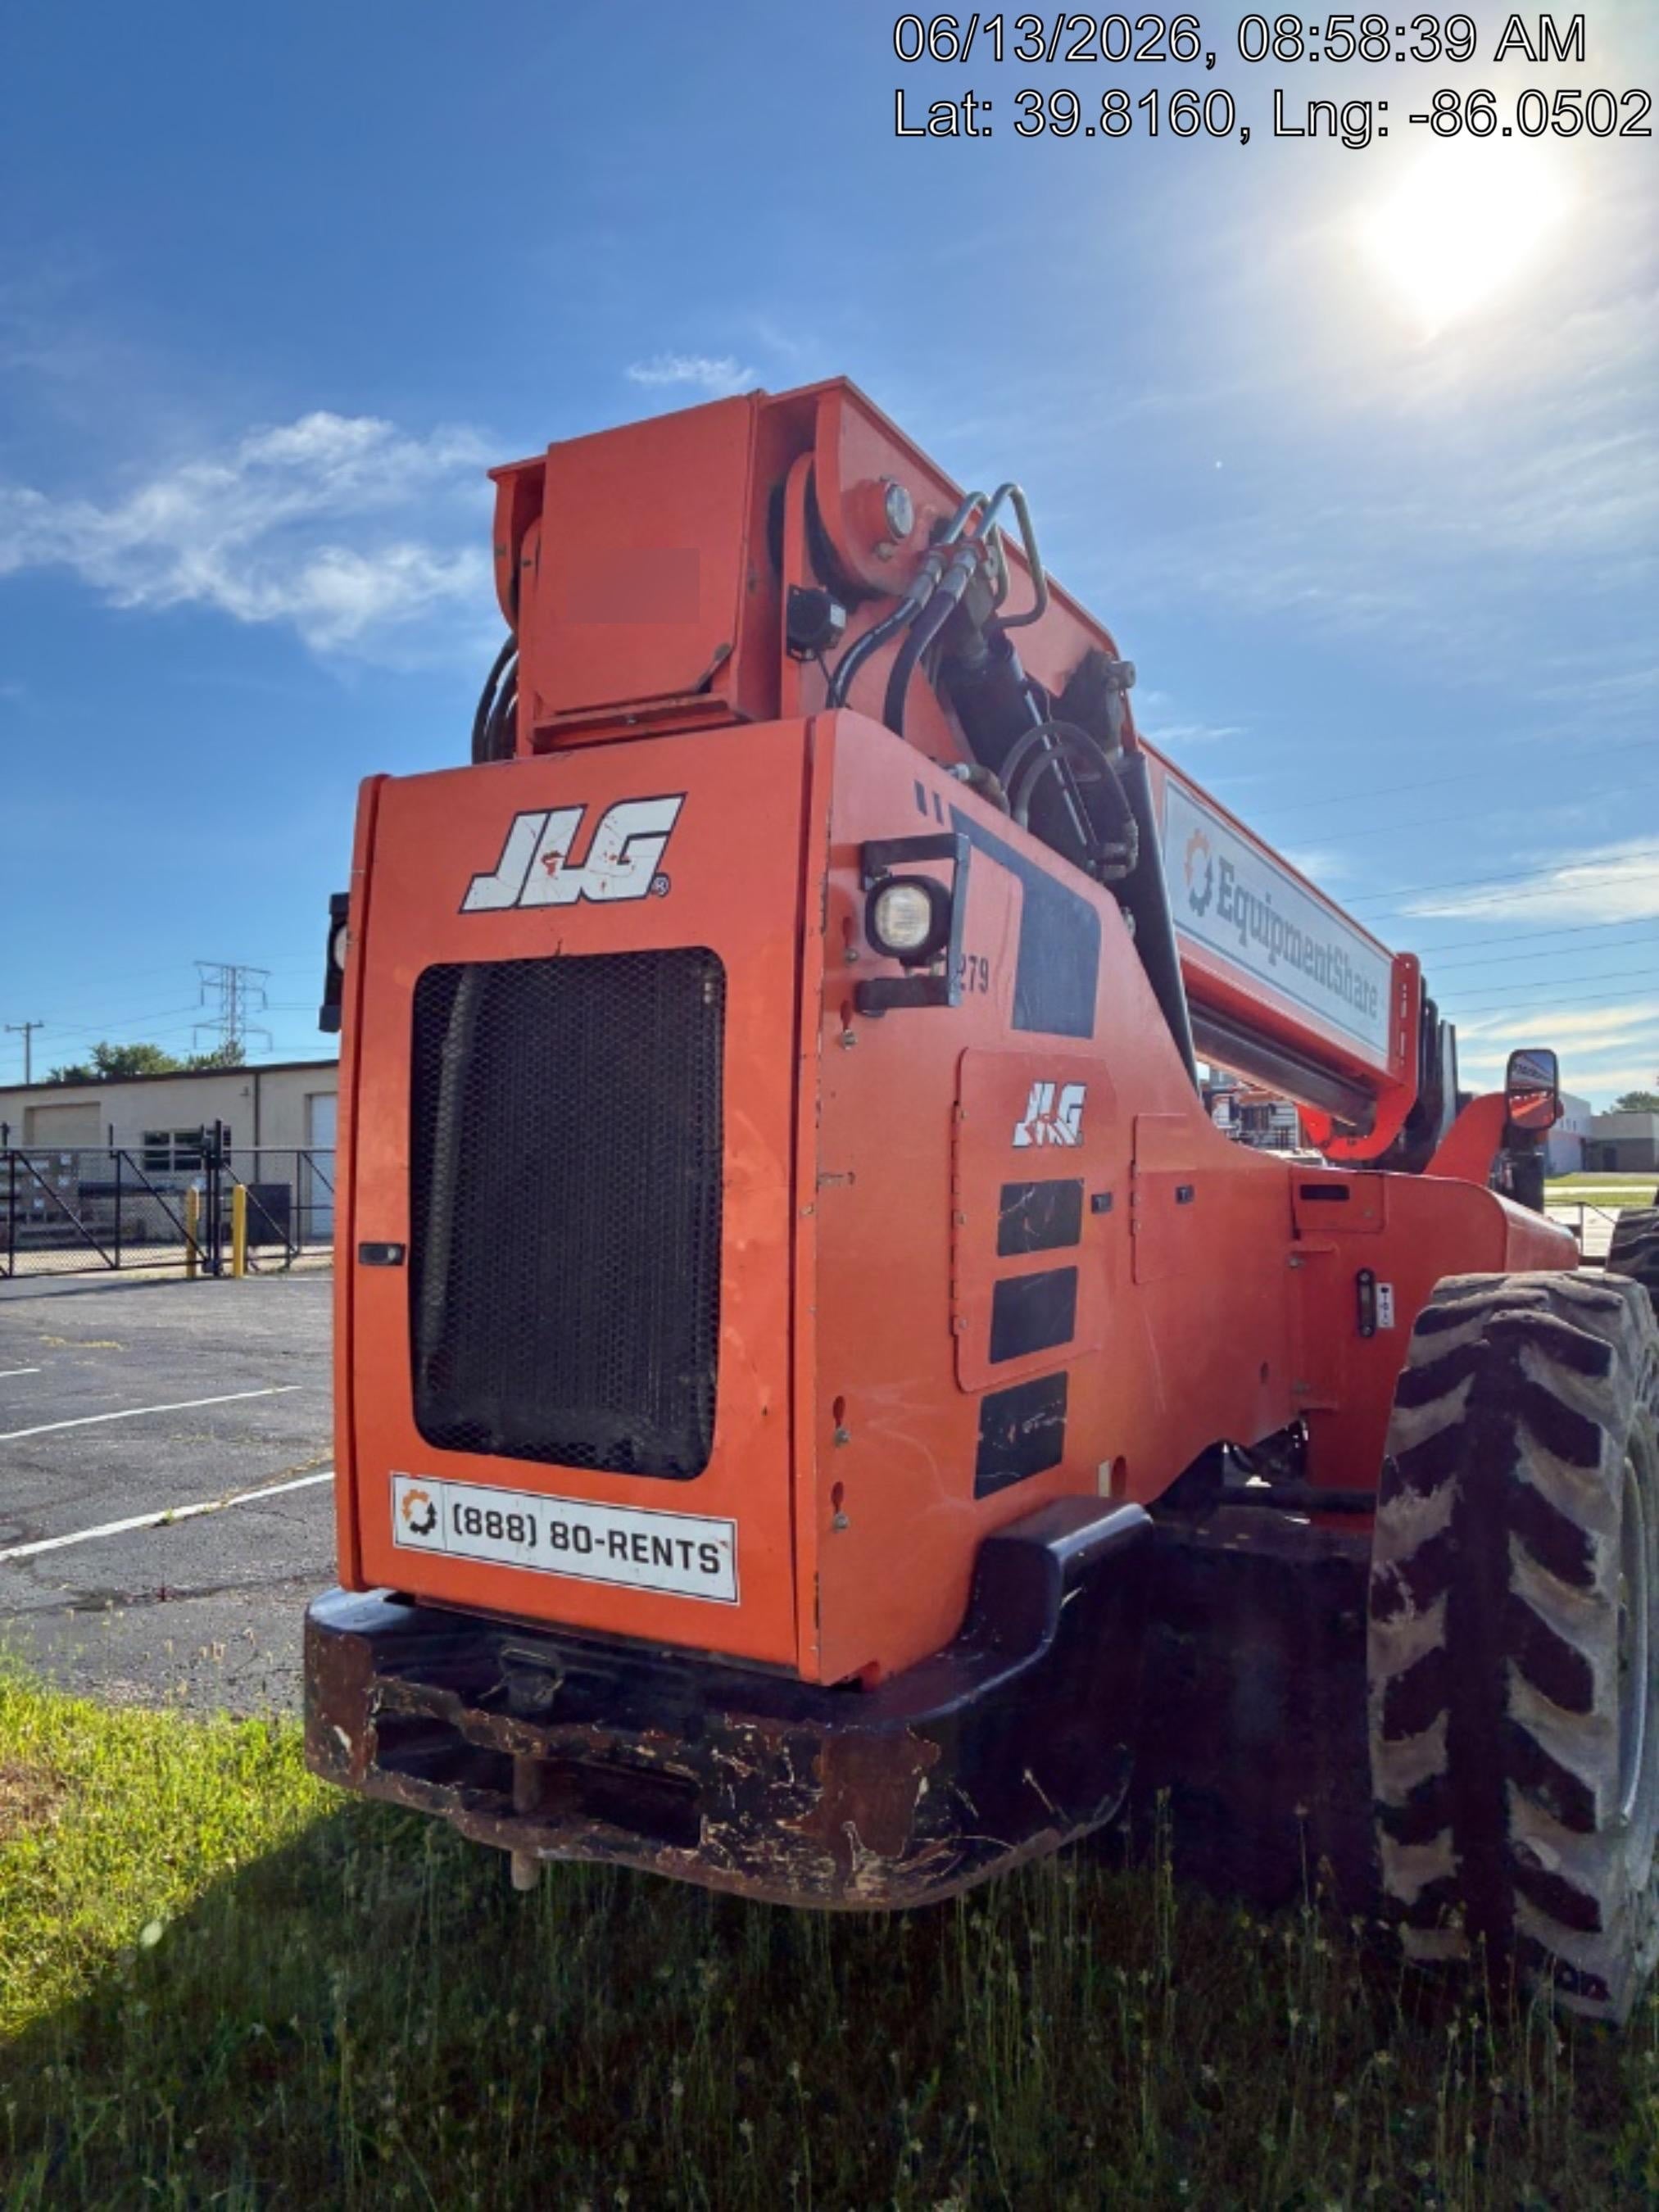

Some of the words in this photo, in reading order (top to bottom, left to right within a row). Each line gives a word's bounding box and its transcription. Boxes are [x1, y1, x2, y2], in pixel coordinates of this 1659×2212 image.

[1217, 854, 1379, 1019] EquipmentShare
[453, 1503, 537, 1548] (888)
[549, 1520, 721, 1575] 80-RENTS
